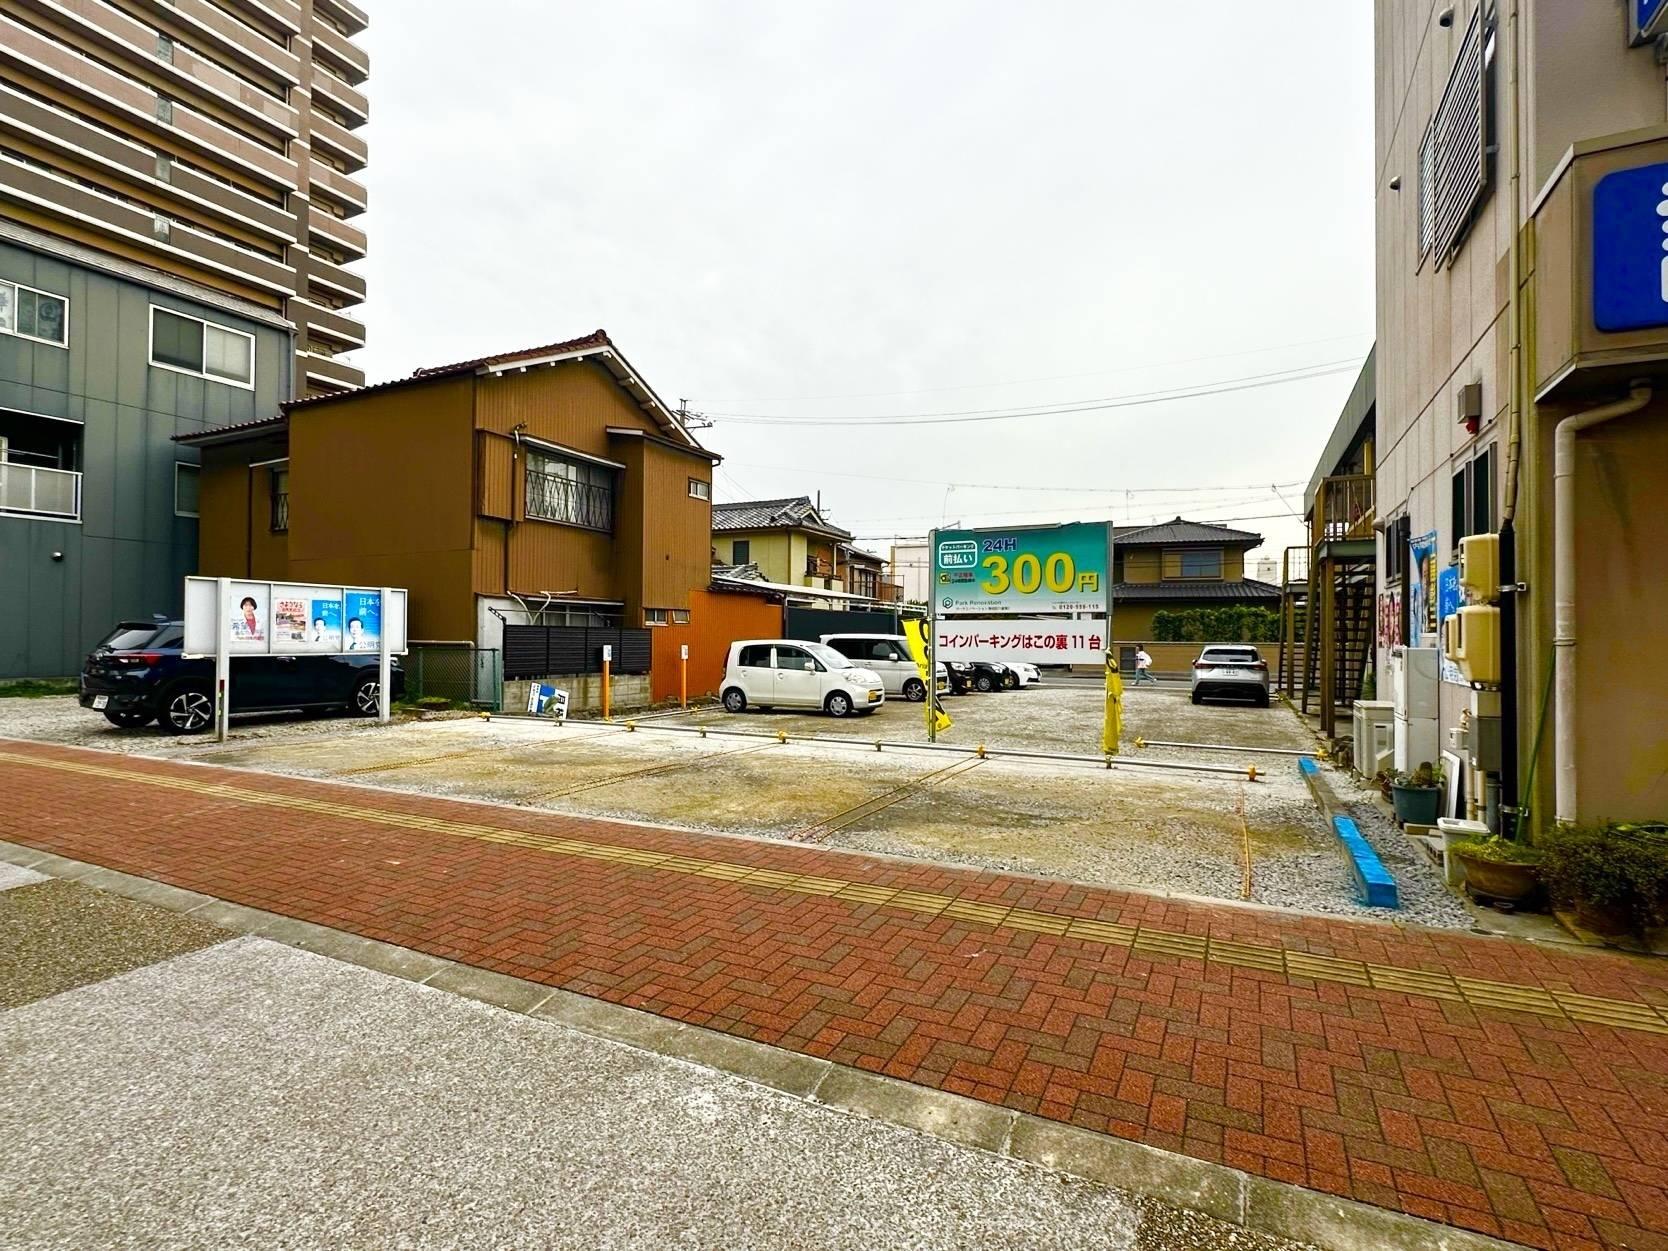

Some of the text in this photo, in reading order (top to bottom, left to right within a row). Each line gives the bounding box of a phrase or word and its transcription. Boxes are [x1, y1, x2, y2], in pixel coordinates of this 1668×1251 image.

[982, 537, 1017, 553] 24H
[943, 553, 973, 565] 前払い
[981, 552, 1099, 595] 300円
